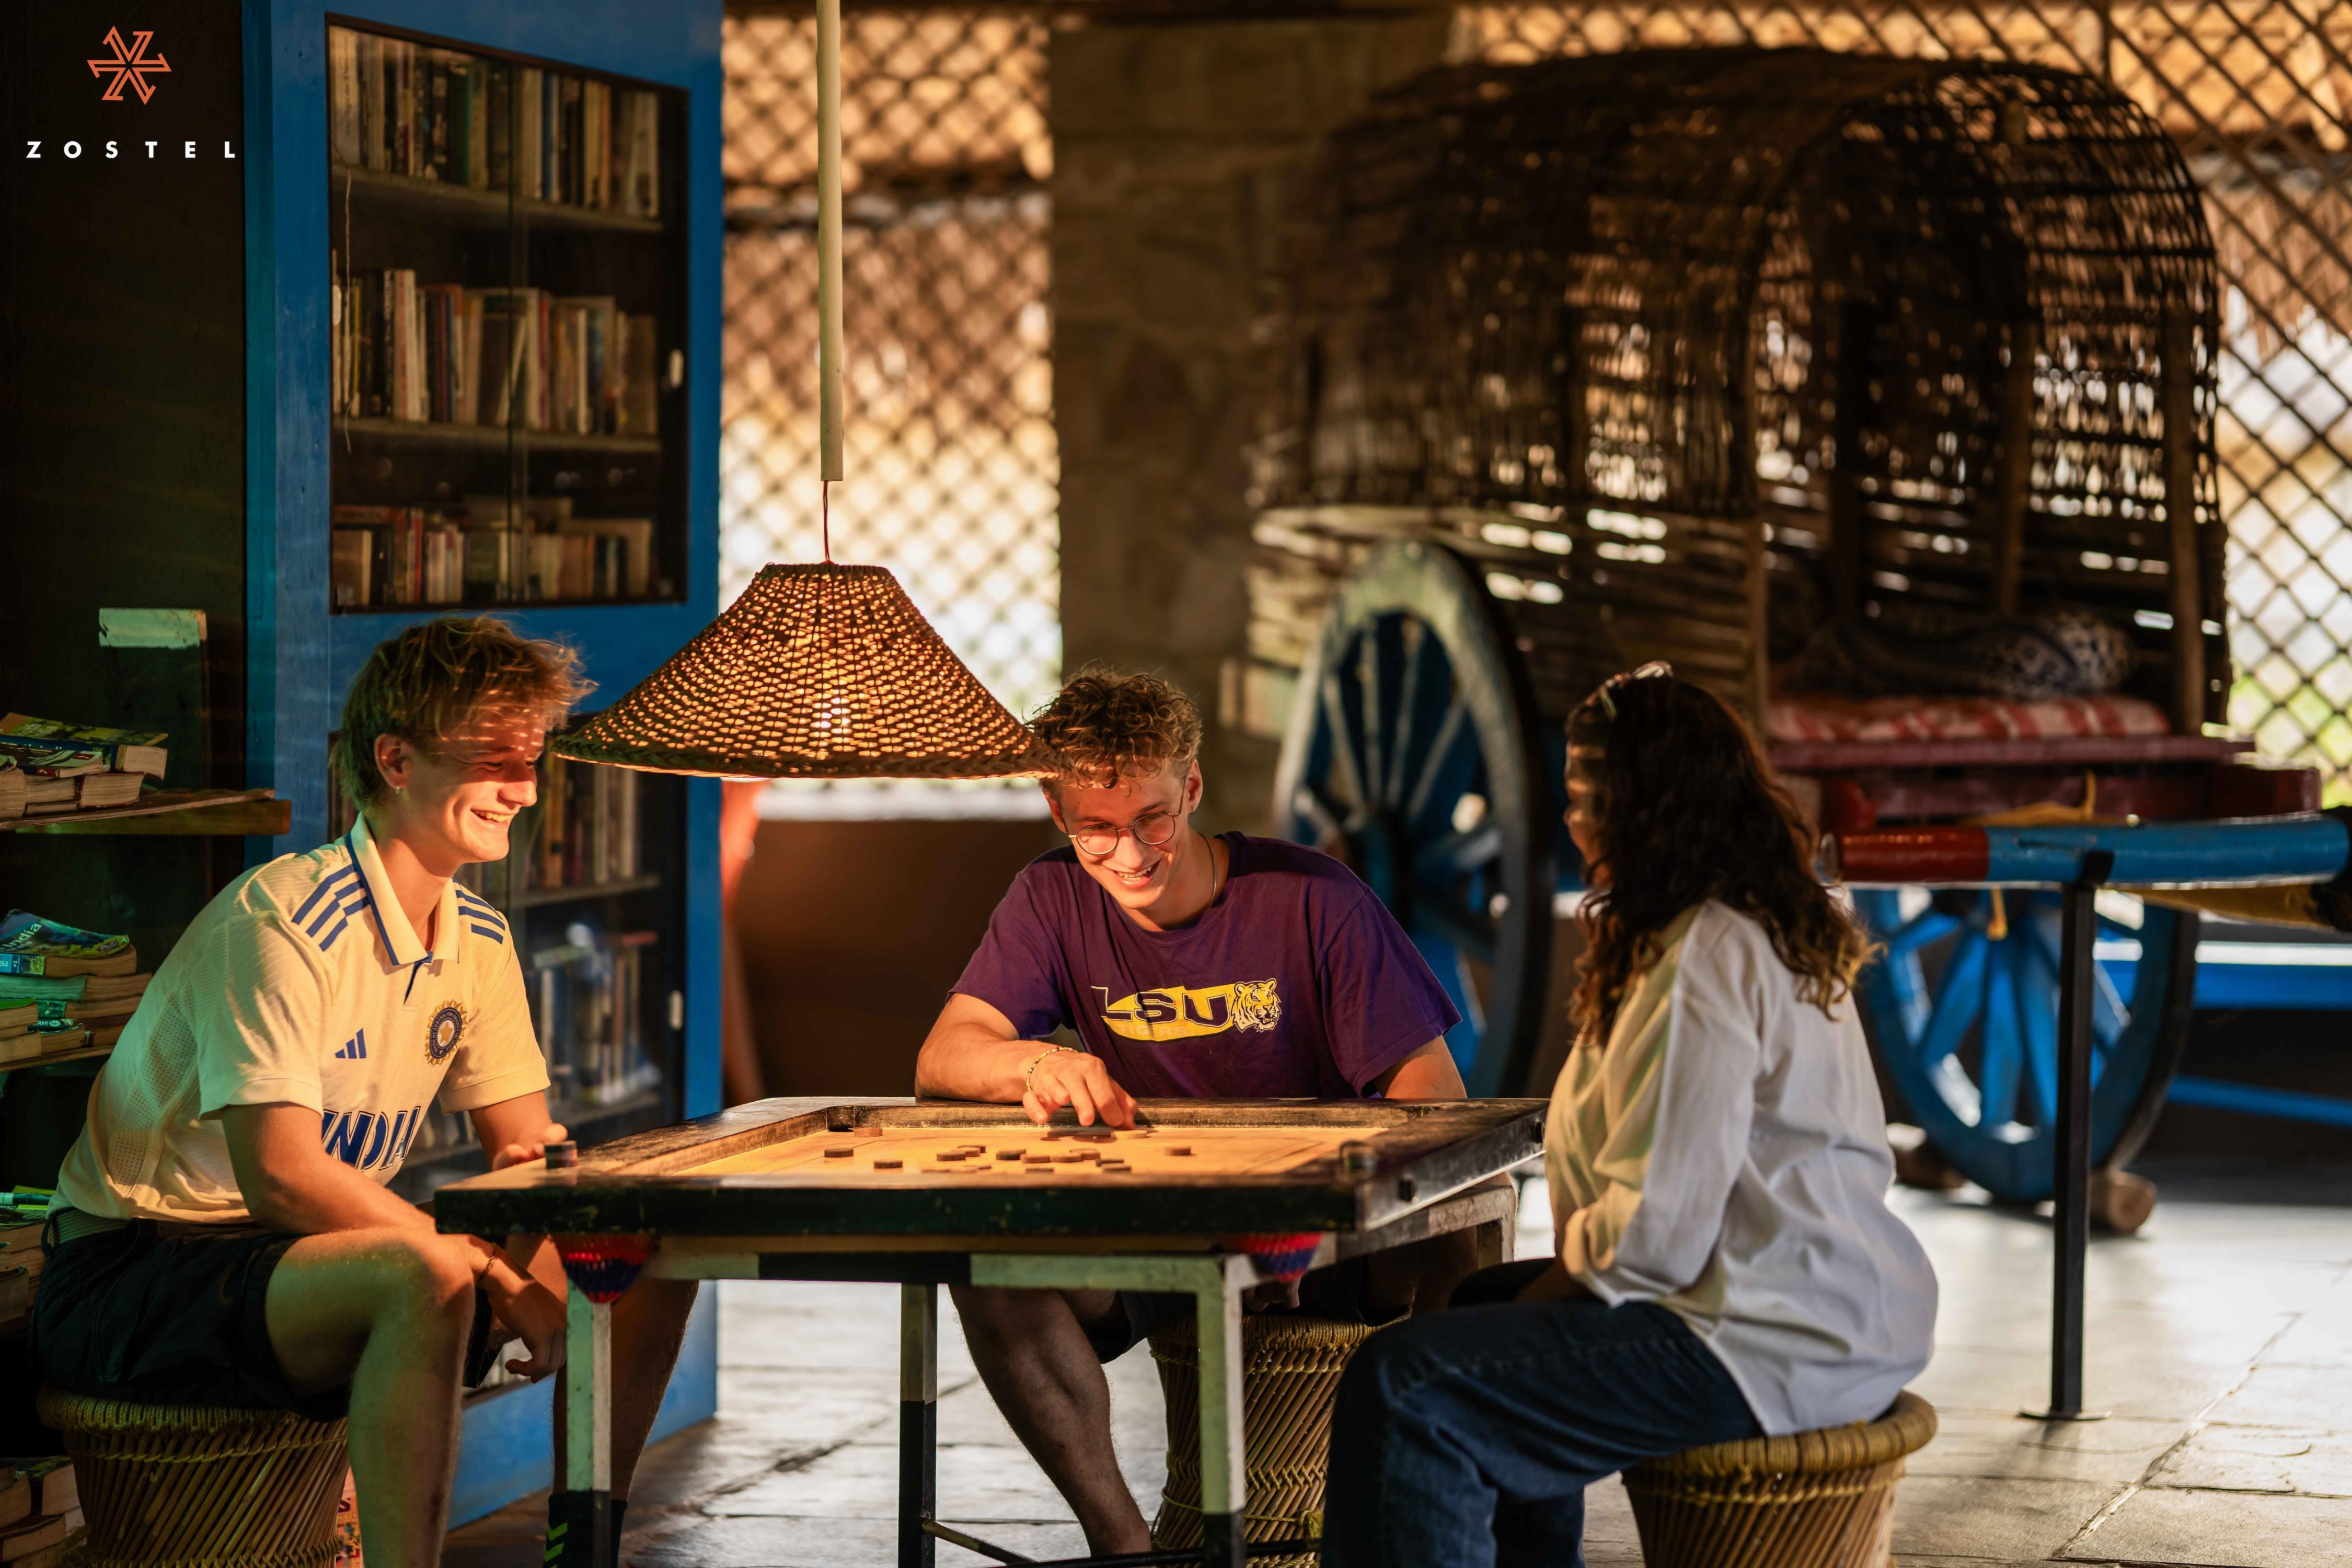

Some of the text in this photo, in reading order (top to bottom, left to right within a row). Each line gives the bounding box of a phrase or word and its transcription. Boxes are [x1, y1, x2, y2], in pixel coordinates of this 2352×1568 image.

[2, 924, 42, 948] India
[1091, 986, 1230, 1028] LSU
[1118, 1024, 1188, 1036] TIGRS
